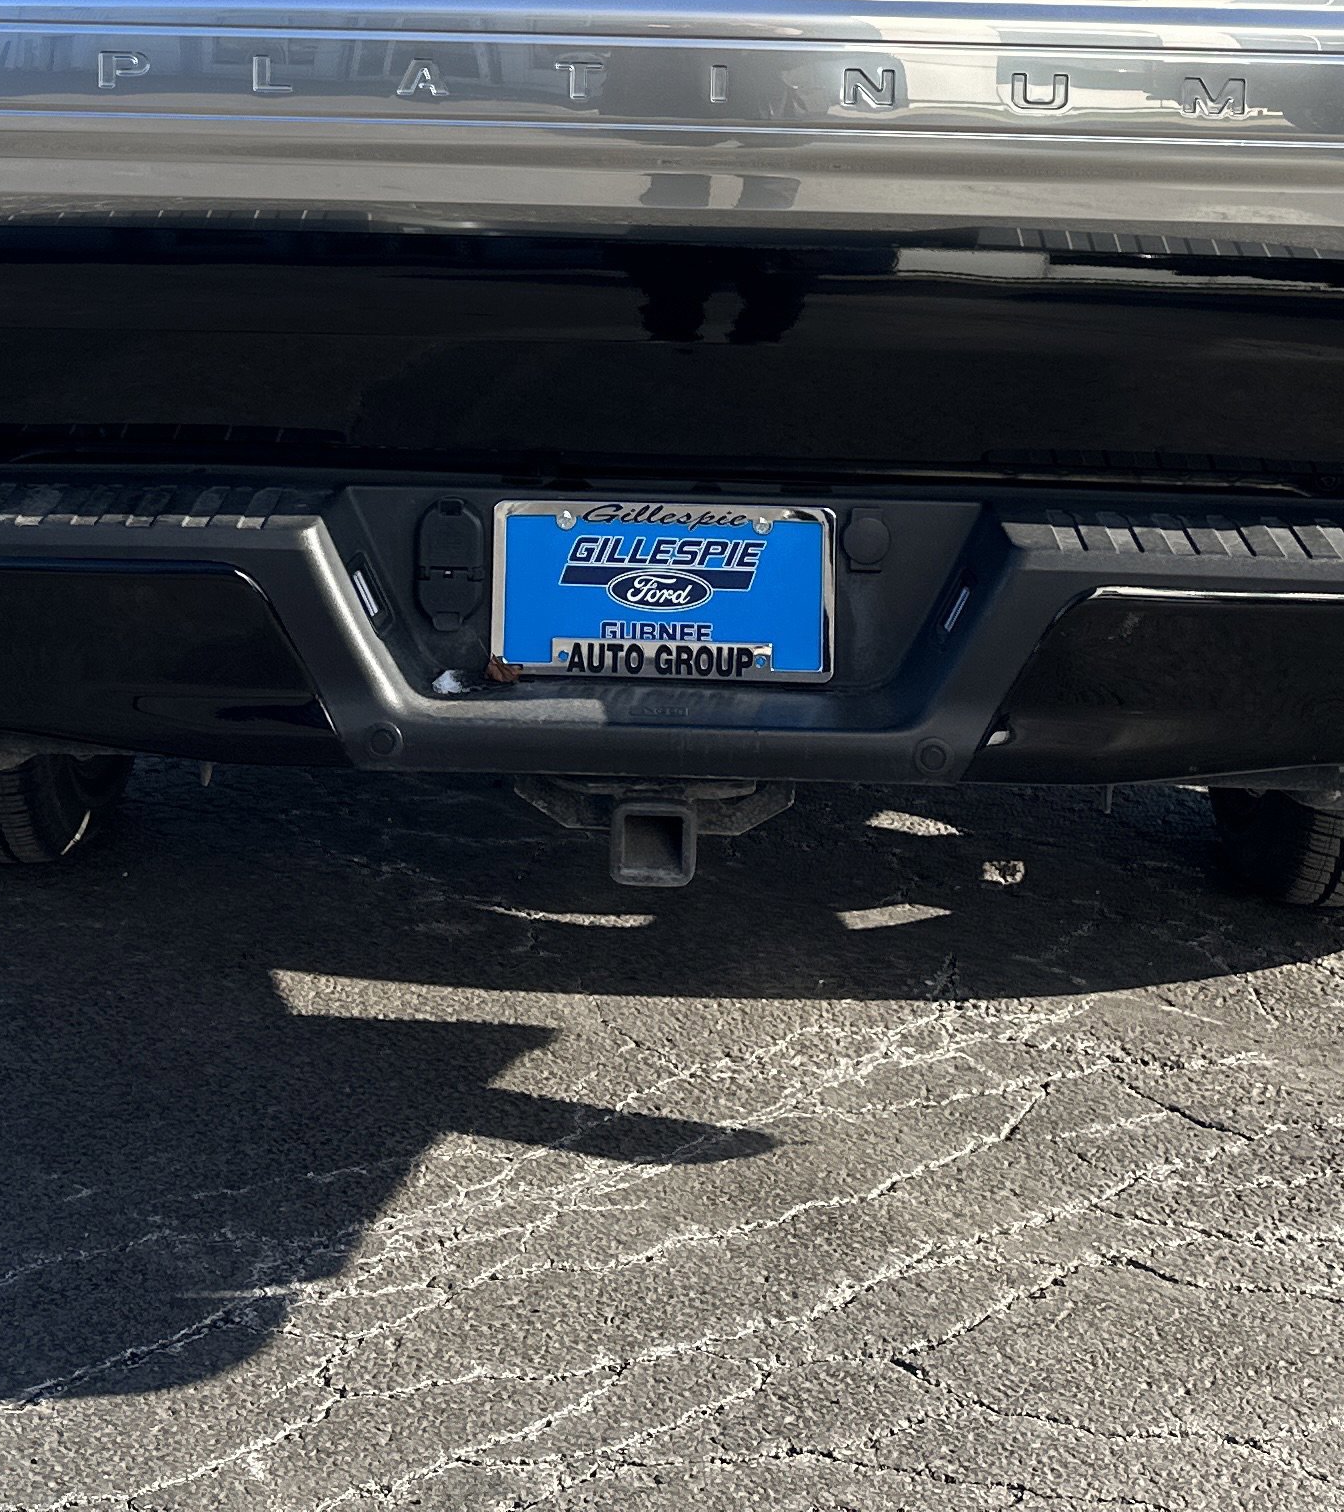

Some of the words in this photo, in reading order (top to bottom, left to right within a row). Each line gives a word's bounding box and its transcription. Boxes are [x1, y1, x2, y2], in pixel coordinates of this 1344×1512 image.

[97, 50, 1248, 118] PLATINUM
[582, 503, 751, 532] Gillespie
[567, 535, 768, 569] GILLESPIE
[626, 575, 692, 605] Ford
[600, 620, 713, 642] GURNEE
[566, 642, 645, 675] AUTO
[654, 644, 754, 678] GROUP
